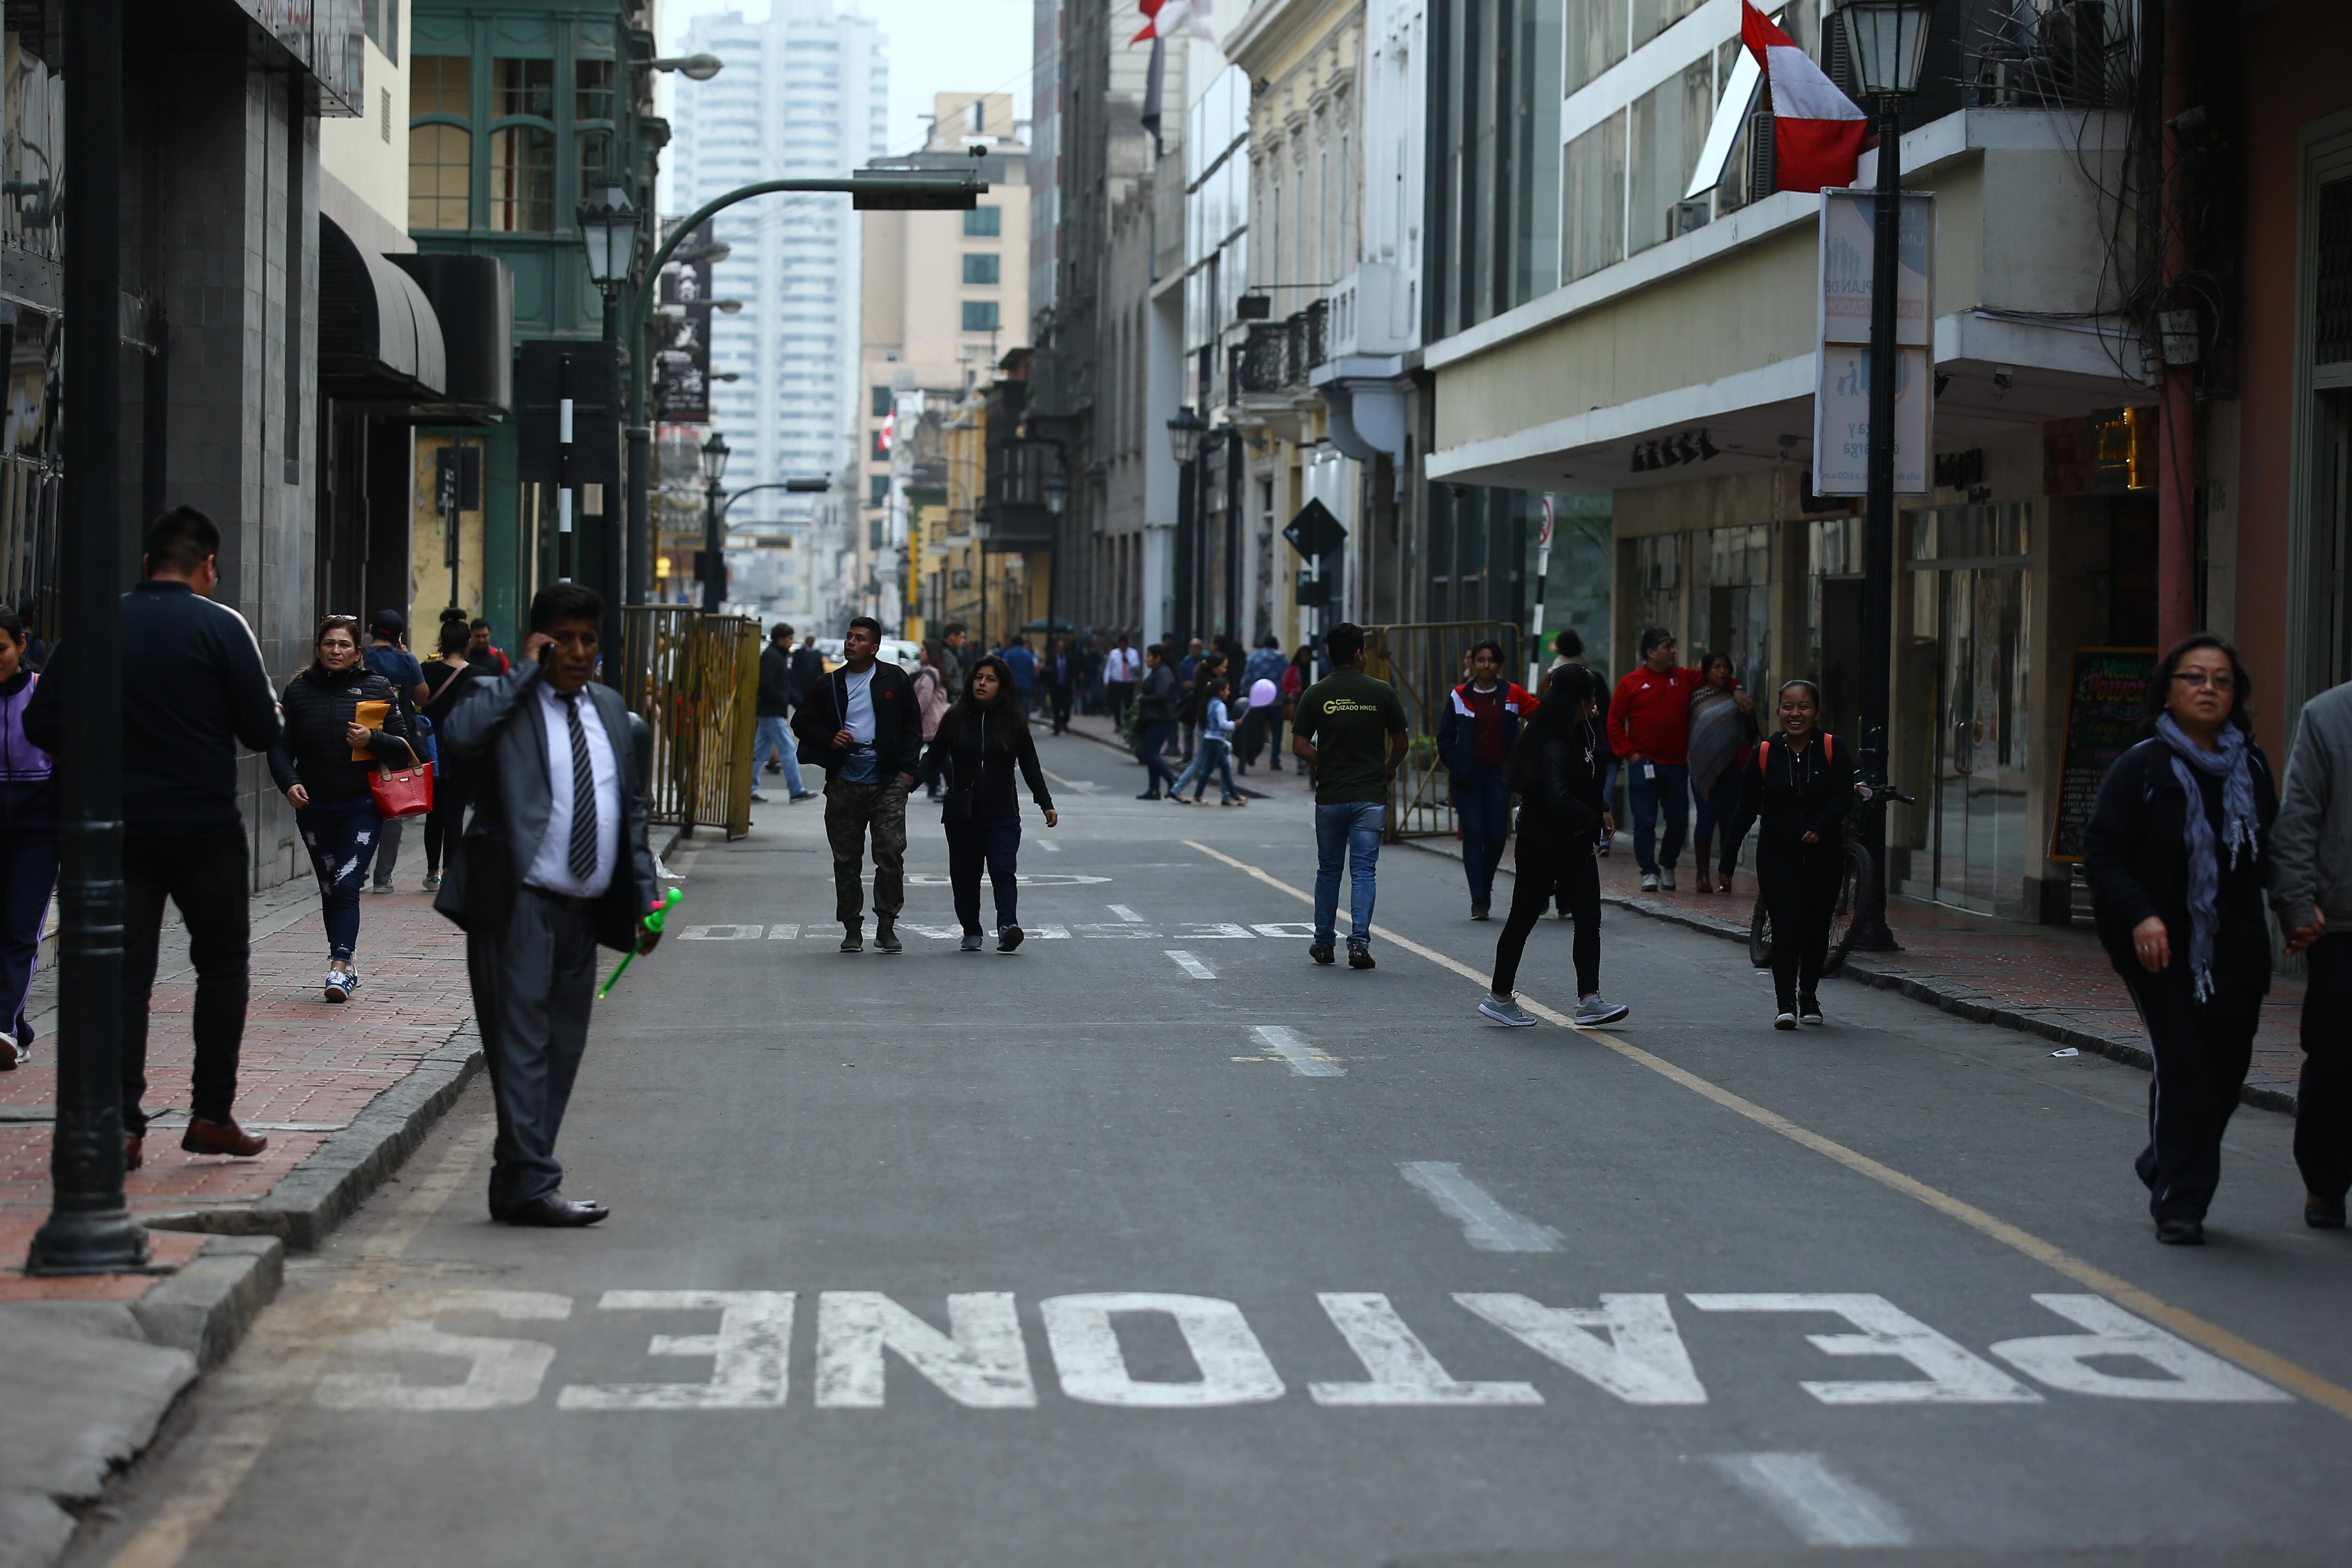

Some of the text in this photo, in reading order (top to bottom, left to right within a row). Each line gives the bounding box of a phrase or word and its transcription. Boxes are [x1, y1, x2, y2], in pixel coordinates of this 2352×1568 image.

[2086, 673, 2146, 702] Power
[1323, 700, 1359, 714] GUIZADO
[313, 1289, 2298, 1410] PEATONES
